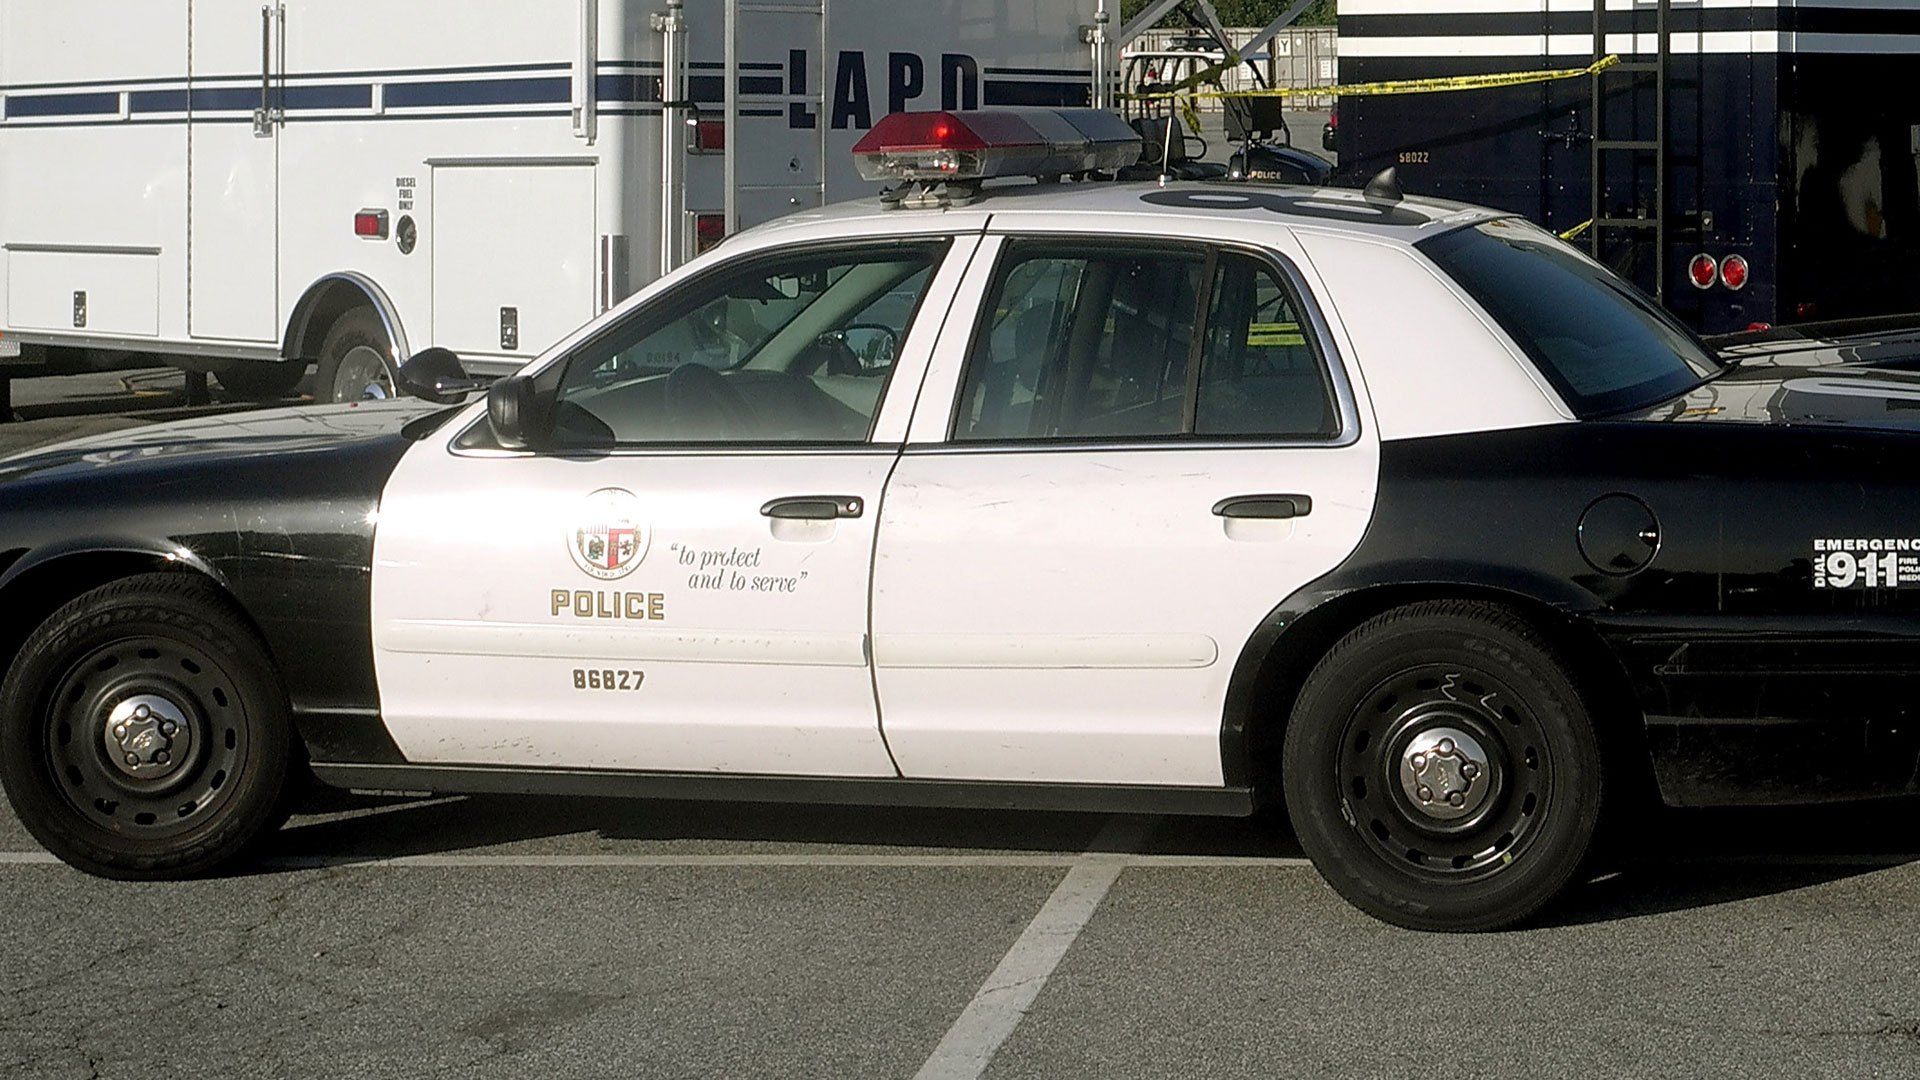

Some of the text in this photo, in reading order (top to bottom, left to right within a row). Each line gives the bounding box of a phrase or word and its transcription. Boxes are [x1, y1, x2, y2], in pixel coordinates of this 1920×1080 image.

[790, 49, 978, 129] LAPD
[1399, 151, 1429, 163] 58022
[1251, 170, 1282, 180] POLICE
[396, 177, 416, 188] DIESEL
[399, 189, 413, 199] FUEL
[399, 200, 413, 210] ONLY
[1814, 539, 1920, 550] EMERGENC
[700, 547, 760, 570] protect
[1899, 557, 1918, 565] FIRE
[1814, 554, 1826, 588] DIAL
[688, 568, 724, 590] and
[730, 570, 746, 590] to
[551, 589, 664, 620] POLICE
[573, 669, 645, 690] 86827
